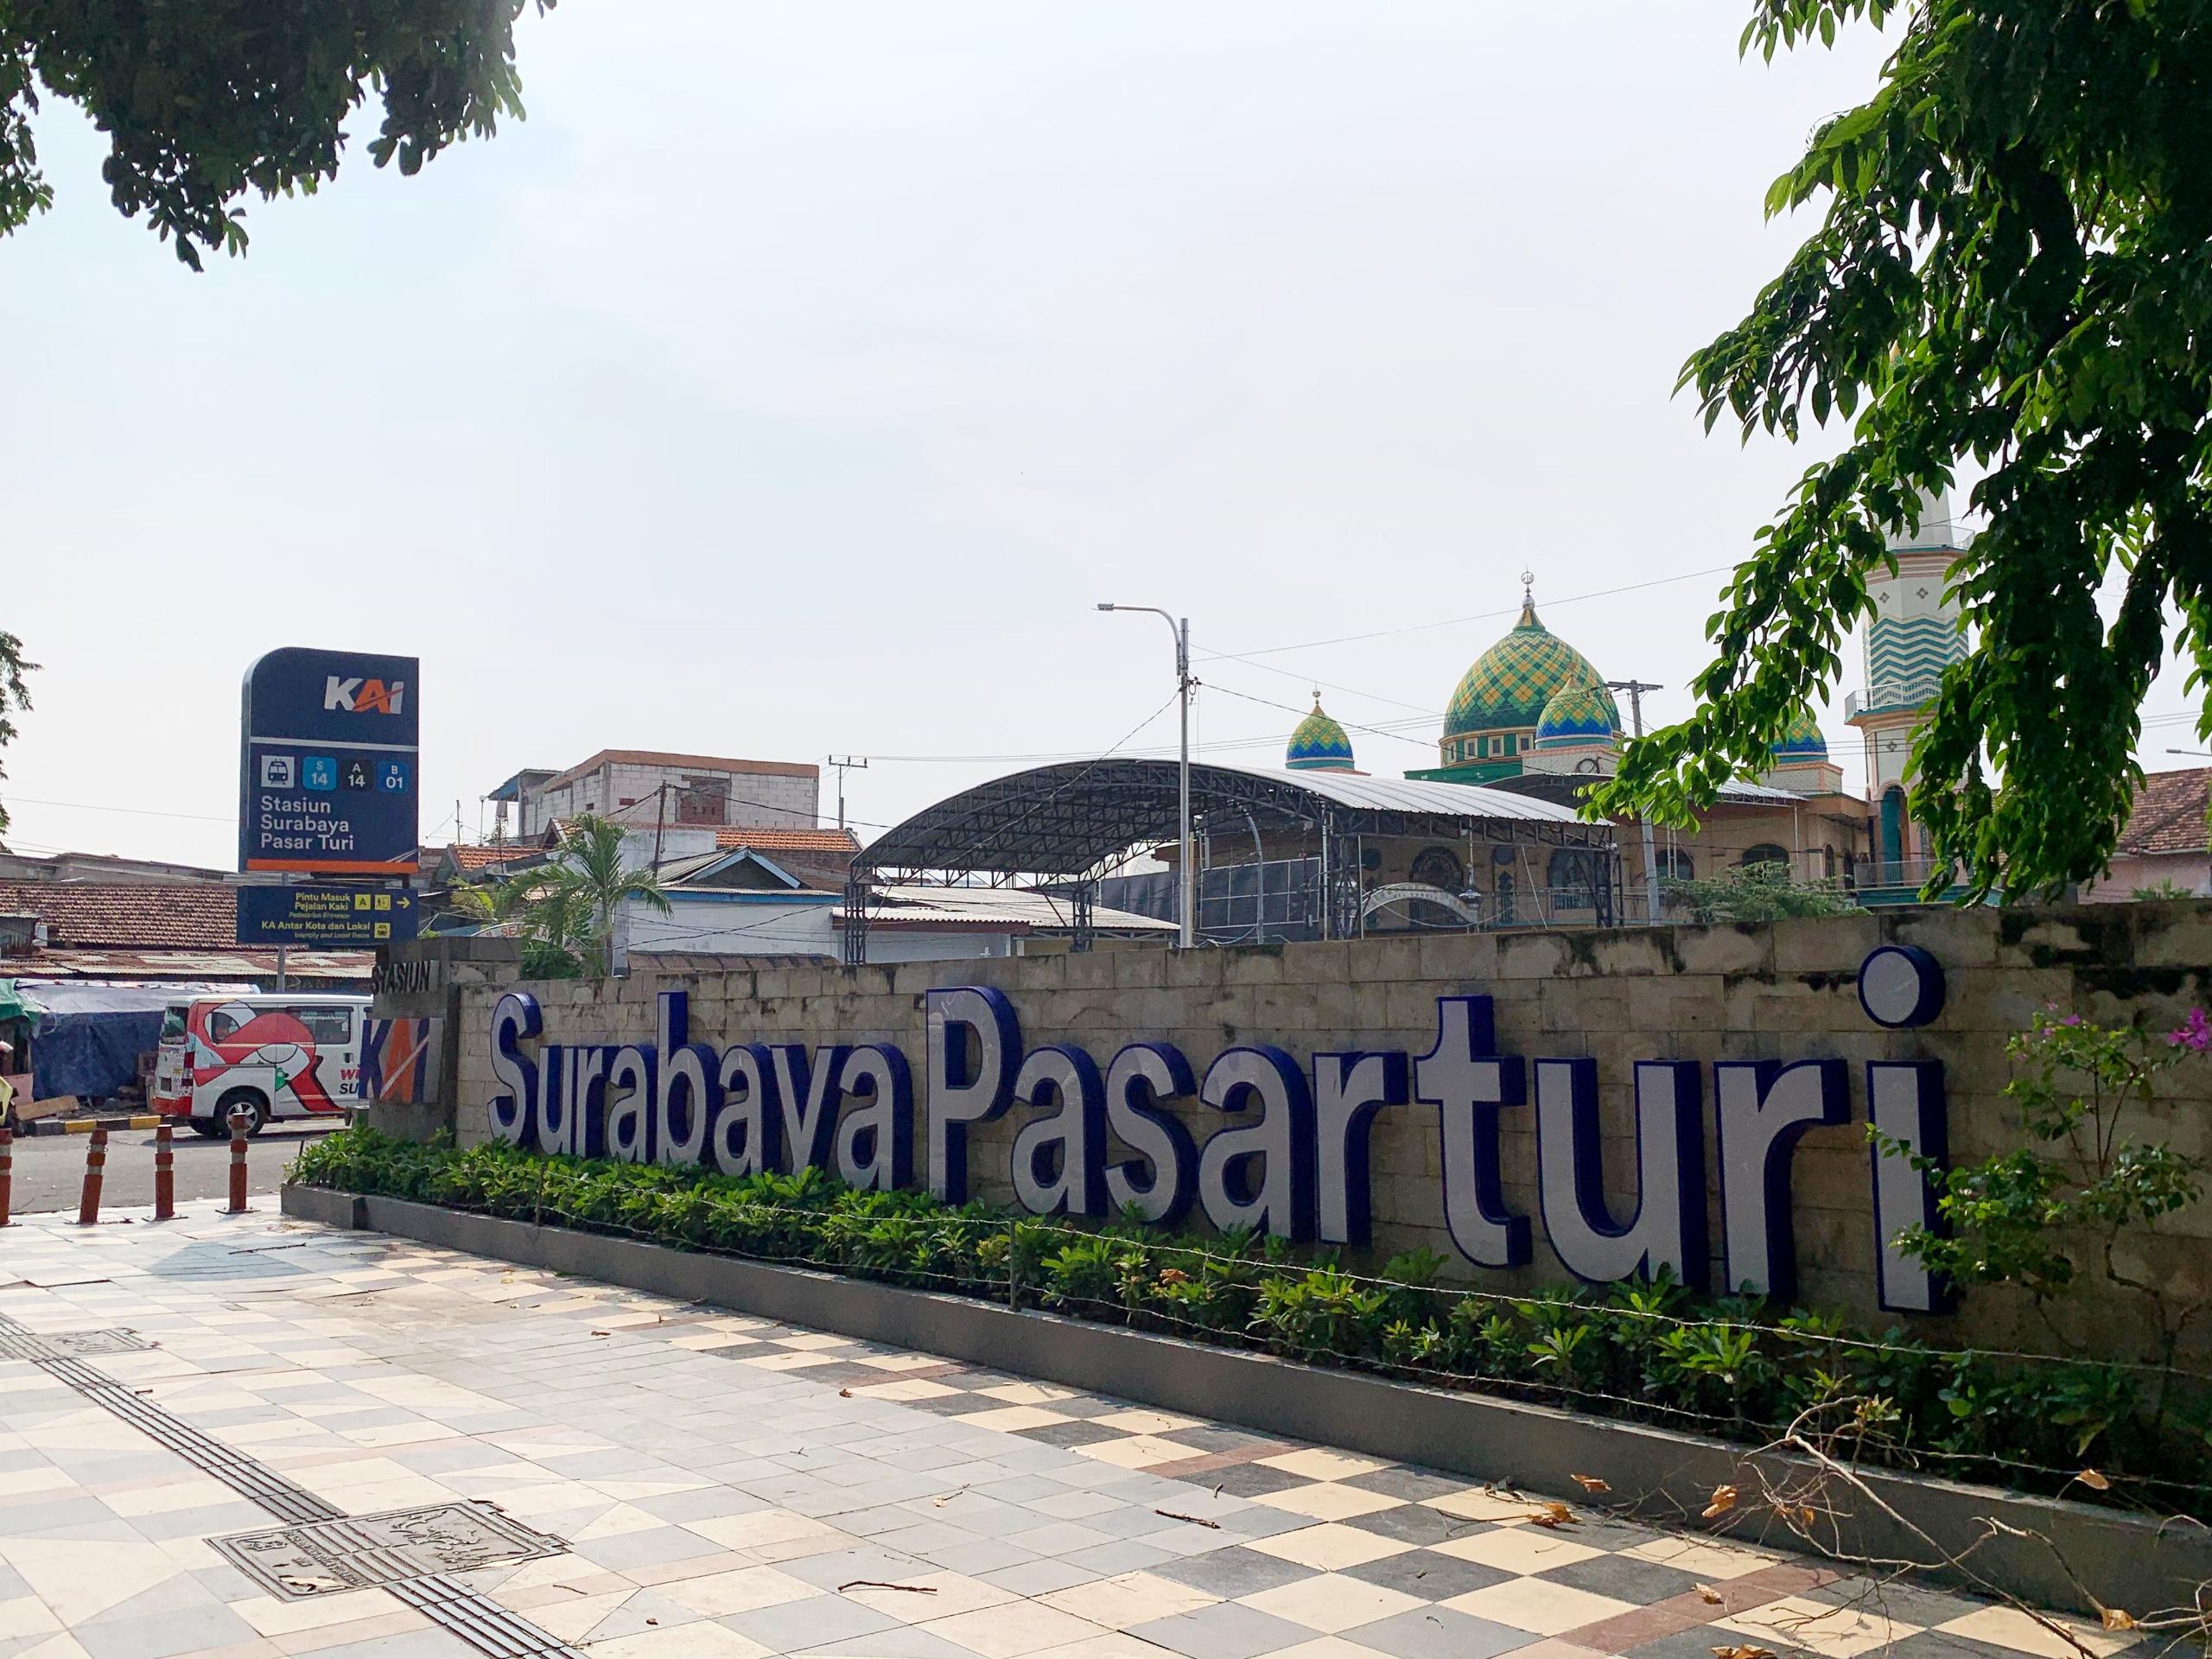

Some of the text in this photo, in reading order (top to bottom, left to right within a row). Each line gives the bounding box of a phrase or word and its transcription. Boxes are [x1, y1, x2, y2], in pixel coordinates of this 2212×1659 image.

[324, 676, 404, 715] KAI
[316, 760, 324, 771] S
[353, 763, 361, 772] A
[391, 766, 398, 775] B
[311, 773, 328, 785] 14
[348, 774, 365, 787] 14
[261, 795, 331, 813] Stasiun
[261, 814, 349, 836] Surabaya
[261, 832, 354, 850] Pasar Turi
[296, 893, 351, 902] Pintu Masuk
[359, 898, 366, 906] A
[295, 901, 349, 912] Pejalan Kaki
[261, 921, 371, 931] KA Antar Kota dan Lokal
[372, 960, 432, 995] STASIUN
[359, 1018, 432, 1103] KAI
[487, 991, 914, 1192] Surabaya
